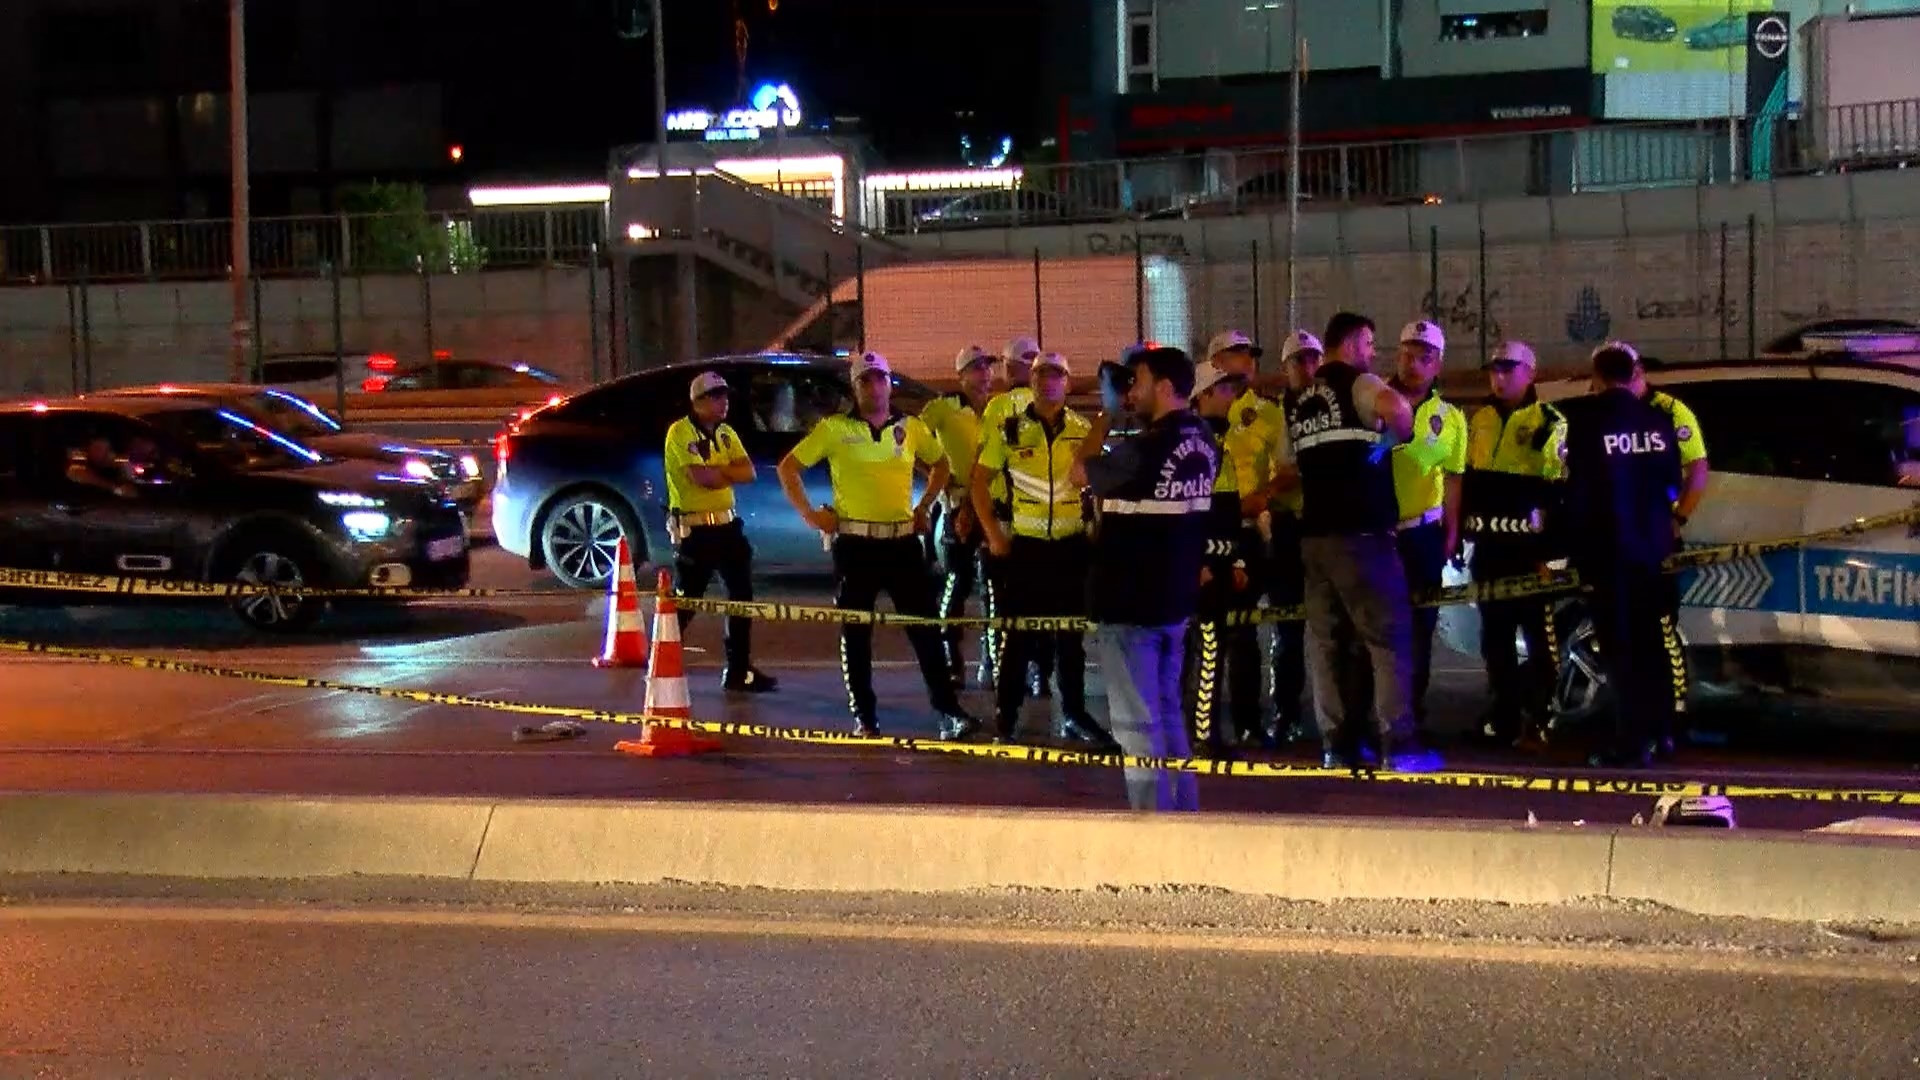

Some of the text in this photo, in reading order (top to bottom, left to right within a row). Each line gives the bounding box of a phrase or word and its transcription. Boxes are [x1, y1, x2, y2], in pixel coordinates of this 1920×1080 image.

[1603, 432, 1666, 455] POLİS
[1154, 459, 1176, 498] OLAY
[1170, 473, 1212, 498] POLİS
